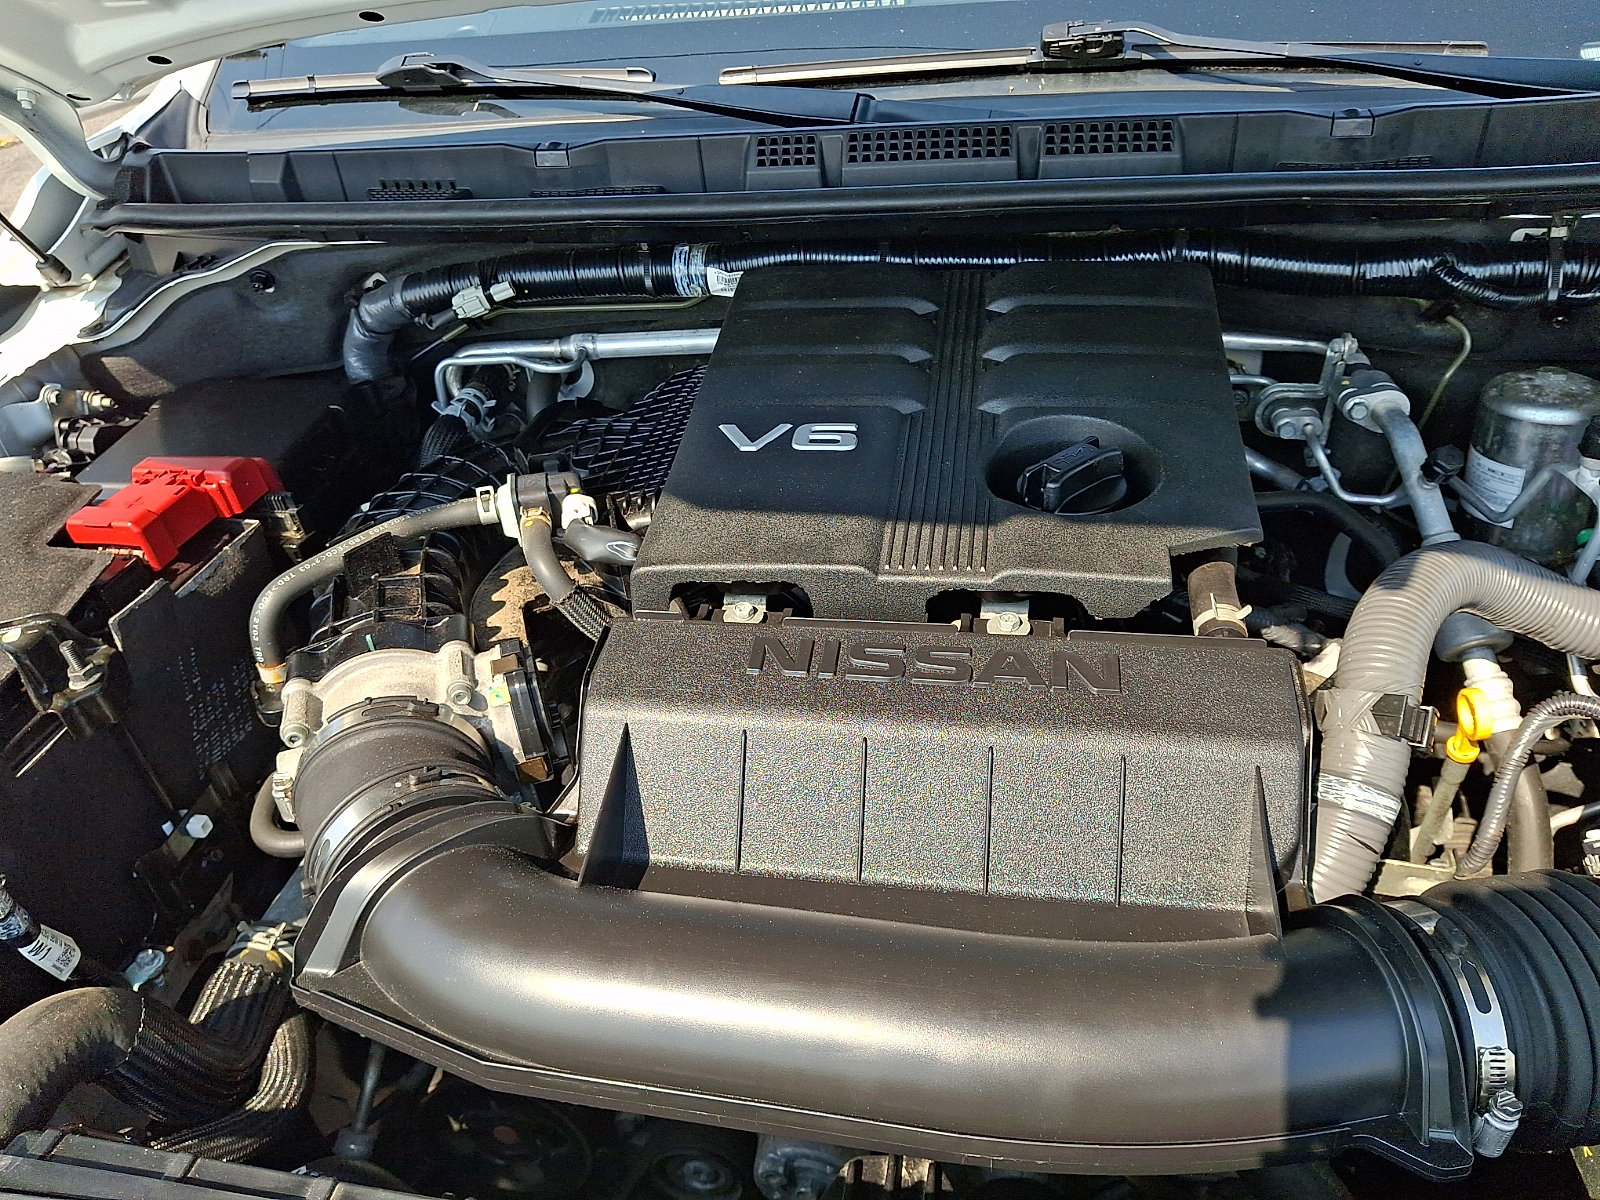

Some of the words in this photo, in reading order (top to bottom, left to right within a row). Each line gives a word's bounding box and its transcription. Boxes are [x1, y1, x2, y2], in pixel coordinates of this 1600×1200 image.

[718, 423, 859, 452] V6
[746, 636, 1127, 695] NISSAN
[27, 939, 53, 962] W1
